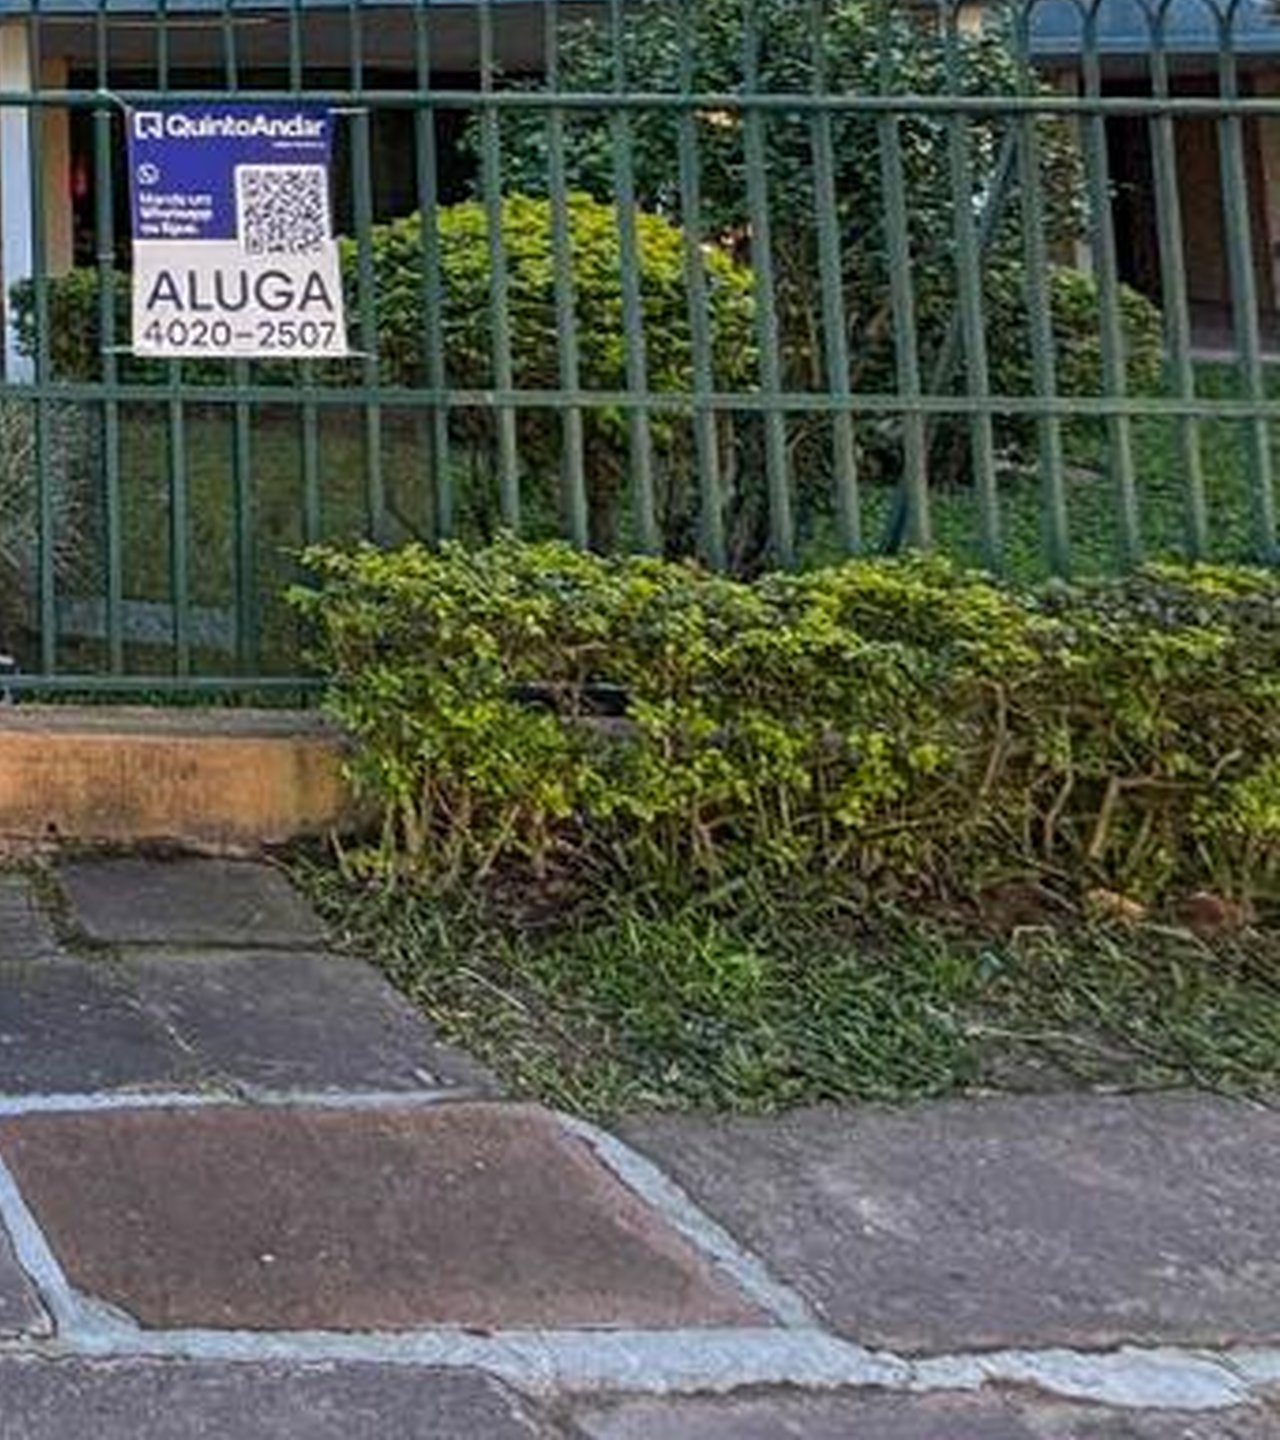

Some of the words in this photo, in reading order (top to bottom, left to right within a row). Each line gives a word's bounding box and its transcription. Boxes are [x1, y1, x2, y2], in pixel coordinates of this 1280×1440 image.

[166, 114, 325, 139] QuintoAndar
[146, 270, 334, 311] ALUGA
[144, 320, 336, 349] 4020-2507
